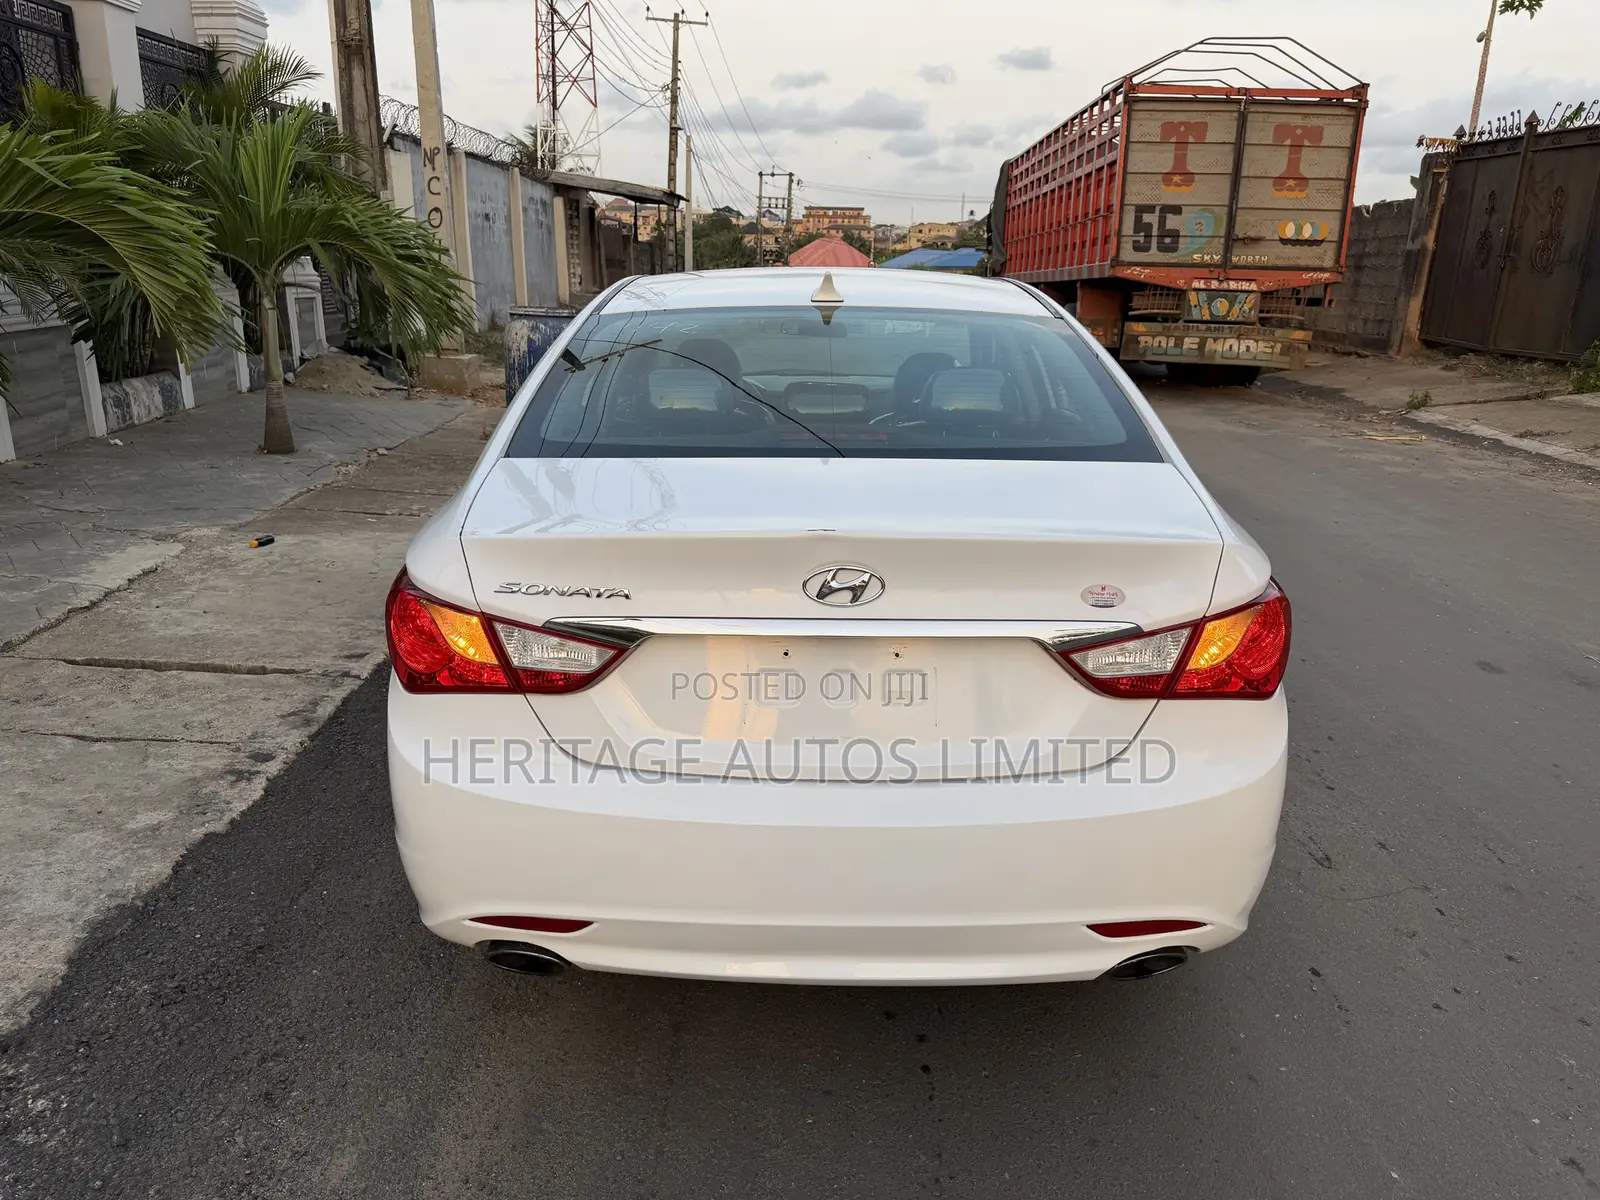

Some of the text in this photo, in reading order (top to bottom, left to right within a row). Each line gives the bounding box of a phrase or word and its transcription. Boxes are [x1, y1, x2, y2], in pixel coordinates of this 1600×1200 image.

[1131, 205, 1183, 253] 56
[1204, 337, 1292, 363] MODEL
[493, 582, 633, 600] SONATA
